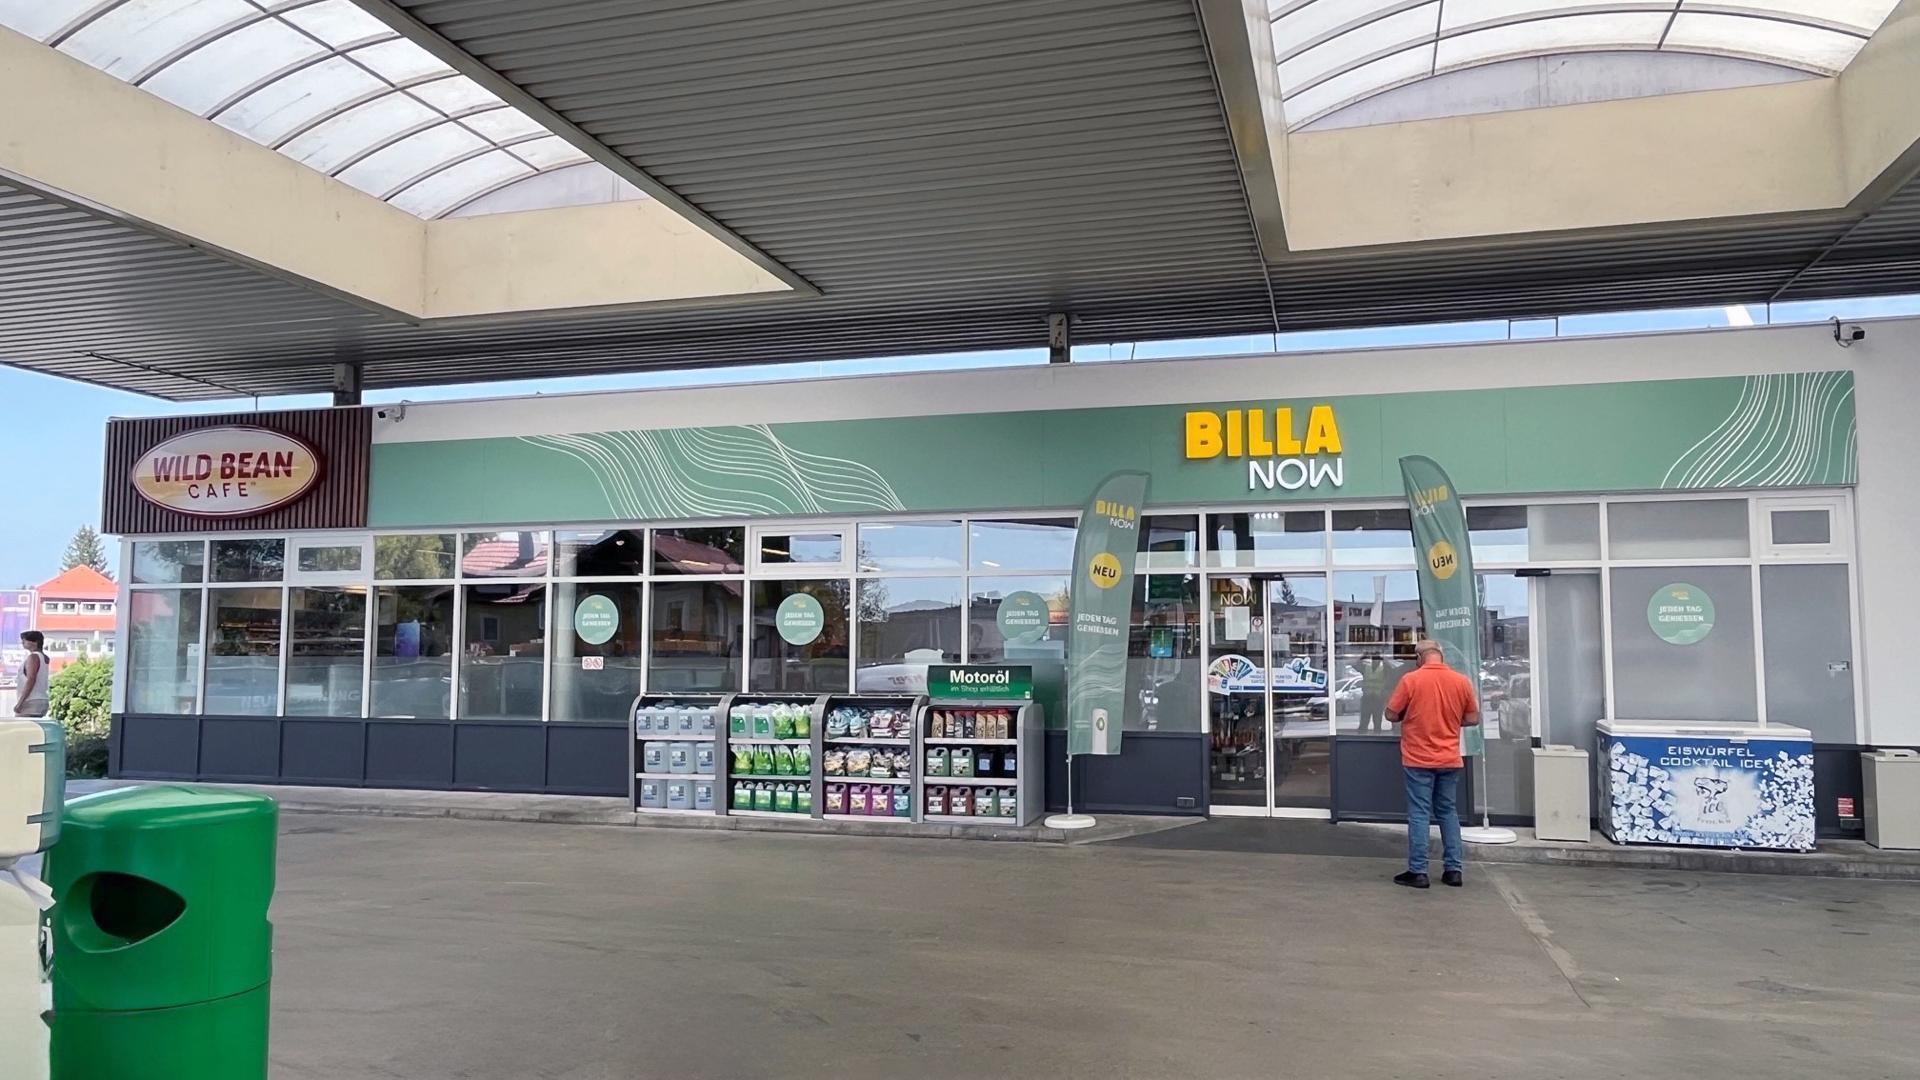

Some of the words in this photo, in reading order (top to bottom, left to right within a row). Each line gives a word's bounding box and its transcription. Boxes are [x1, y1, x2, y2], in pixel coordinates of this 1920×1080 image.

[1185, 406, 1343, 459] BILLA
[153, 453, 212, 483] WILD
[220, 451, 294, 480] BEAN
[1249, 457, 1345, 490] NOW
[1095, 500, 1135, 521] BILLA
[1109, 518, 1135, 530] NOW
[1093, 564, 1116, 579] NEU
[1220, 593, 1257, 606] NOW
[1658, 605, 1685, 614] JEDEN
[1077, 613, 1101, 623] JEDEN
[1102, 615, 1117, 625] TAG
[1077, 624, 1119, 636] GENIESSEN
[949, 669, 1010, 684] Motoröl
[1668, 745, 1755, 757] EISWÜRFEL
[1660, 757, 1734, 768] COCKTAIL
[1740, 759, 1764, 769] ICE
